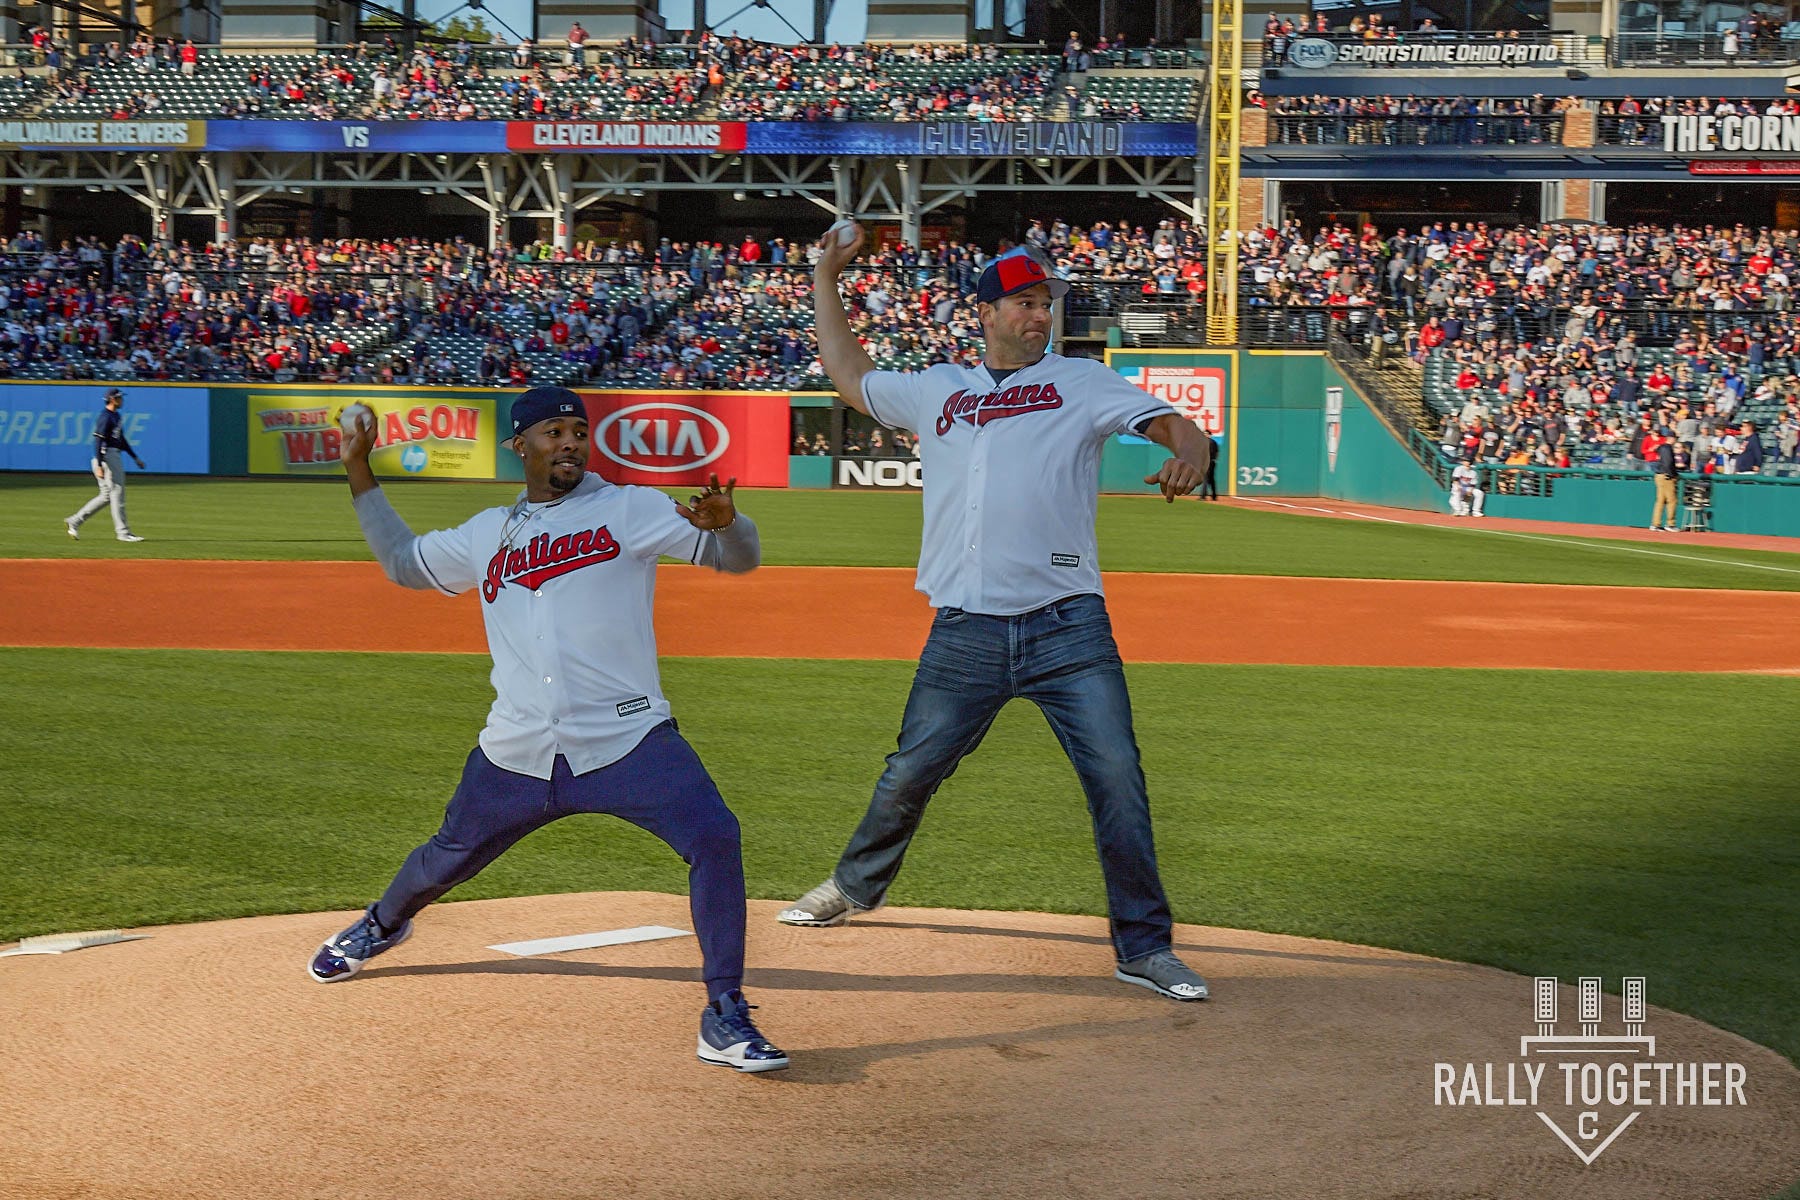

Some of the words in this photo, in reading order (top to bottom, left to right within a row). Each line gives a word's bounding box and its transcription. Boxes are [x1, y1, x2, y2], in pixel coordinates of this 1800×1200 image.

[1300, 44, 1326, 57] FOX
[1455, 45, 1500, 62] OHIO
[1500, 45, 1558, 62] PATIO
[101, 122, 188, 143] BREWERS
[341, 126, 370, 148] VS
[533, 124, 641, 145] CLEVELAND
[643, 124, 721, 146] INDIANS
[918, 122, 1124, 156] CLEVELAND
[1660, 115, 1716, 152] THE
[1721, 115, 1800, 151] CORN
[263, 412, 295, 427] WHO
[299, 410, 328, 425] BUT
[374, 405, 480, 448] ASON
[618, 418, 708, 457] KIA
[1237, 466, 1279, 486] 325
